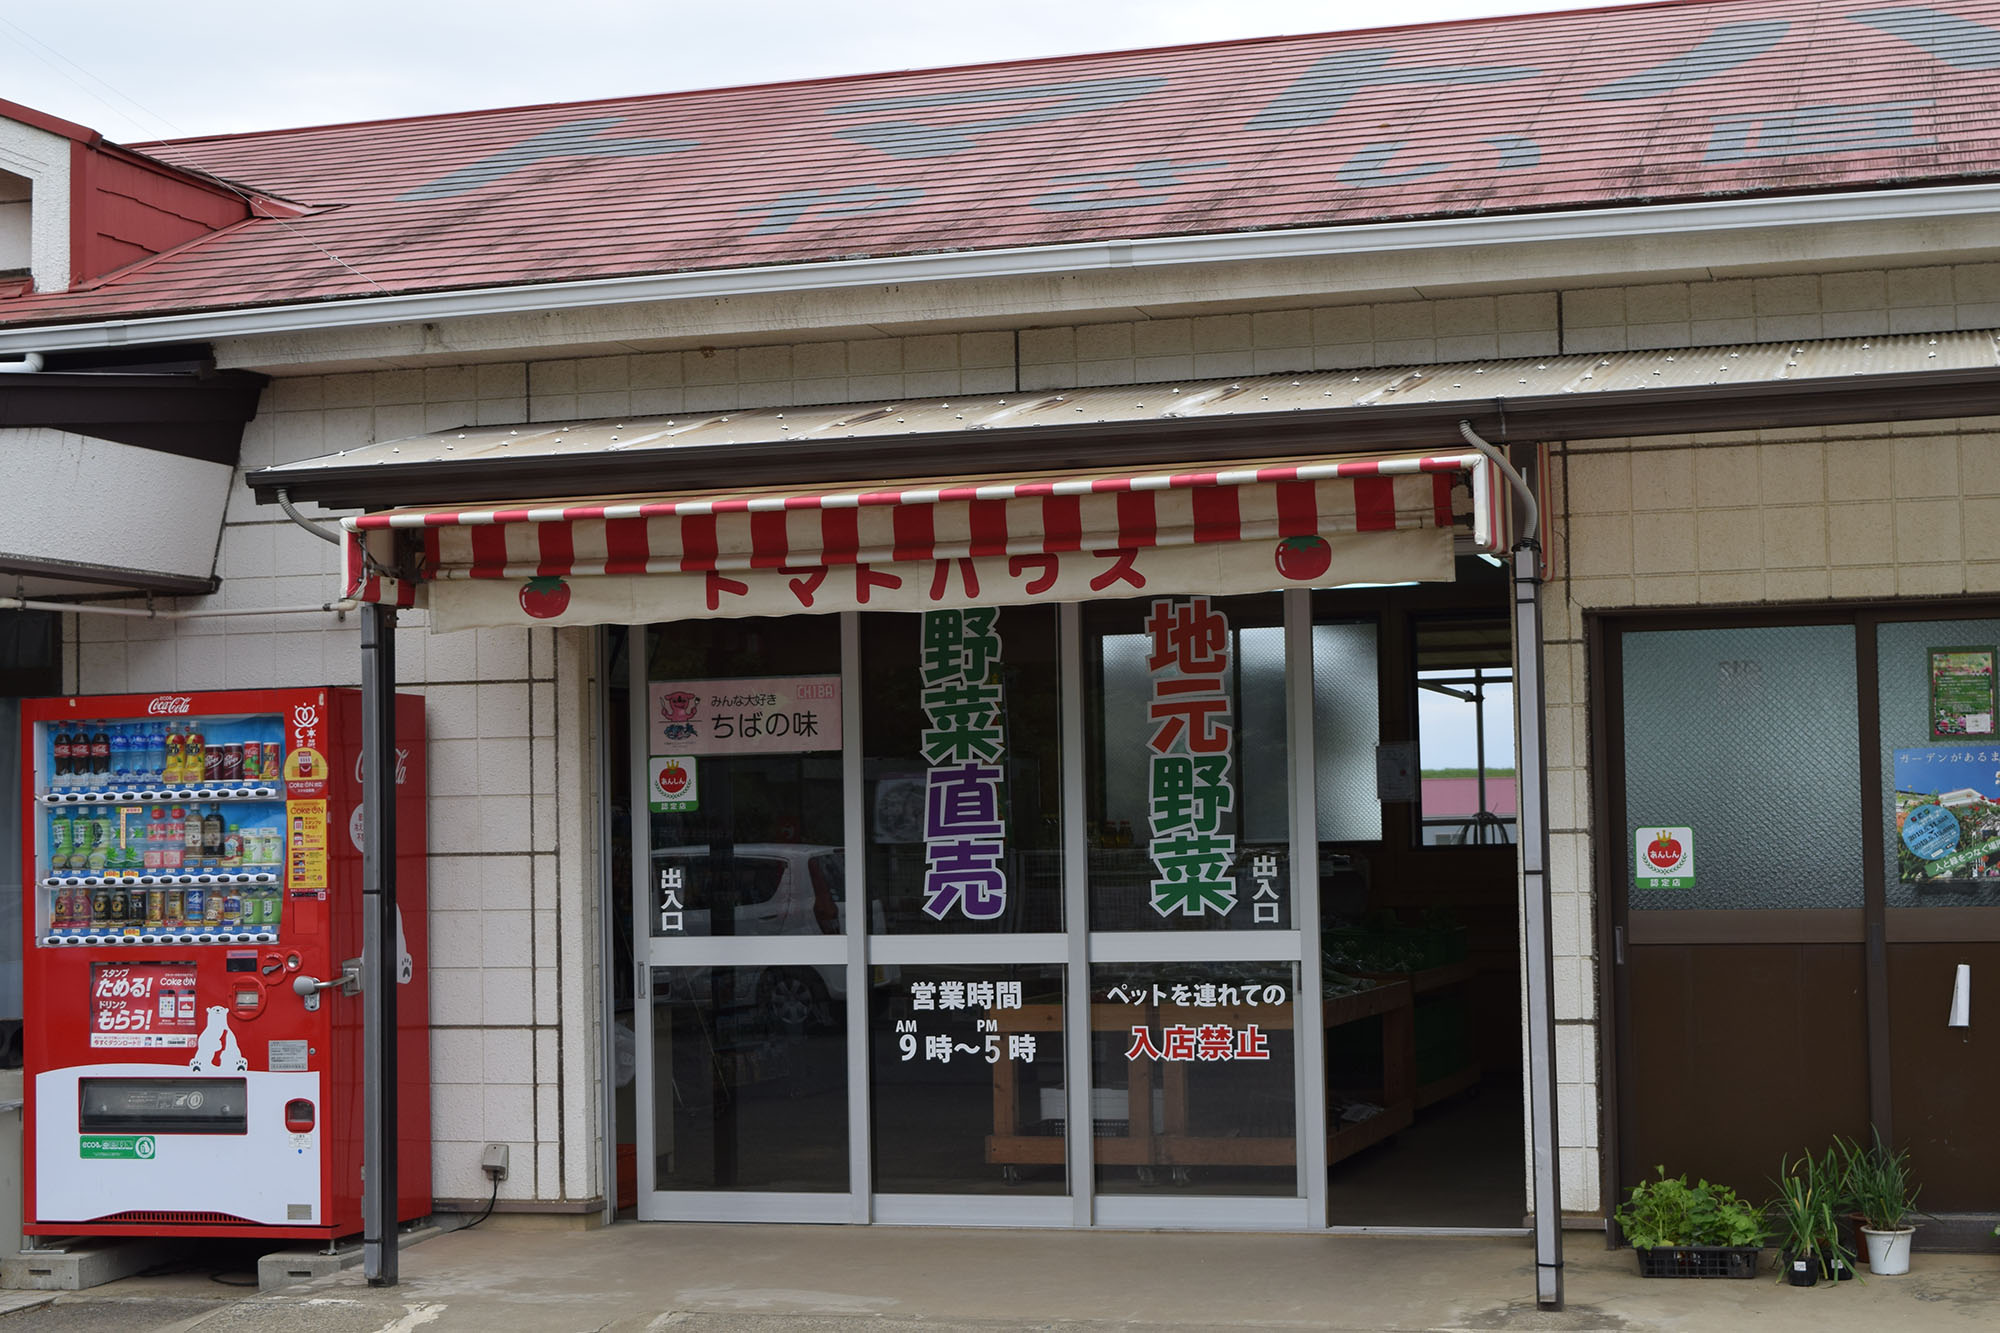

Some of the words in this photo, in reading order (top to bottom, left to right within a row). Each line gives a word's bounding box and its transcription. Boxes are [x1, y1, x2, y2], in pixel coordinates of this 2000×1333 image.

[706, 548, 1146, 611] トマトハウス
[797, 684, 835, 700] CHIBA
[148, 697, 192, 714] Coca-Cola
[711, 694, 777, 707] みんな大好き
[711, 711, 818, 739] ちばの味
[920, 606, 1006, 921] 野菜直売
[1145, 595, 1238, 918] 地元野菜
[661, 777, 687, 786] あんしん
[290, 807, 311, 815] Coke
[1650, 850, 1679, 859] あんしん
[1252, 855, 1279, 924] 出入口
[661, 868, 683, 931] 出入口
[101, 968, 130, 978] スタンプ
[160, 978, 182, 986] Coke
[183, 977, 196, 986] ON
[910, 981, 1022, 1010] 営業時間
[1107, 983, 1286, 1007] ペットを連れての
[99, 1001, 127, 1009] ドリンク
[895, 1020, 917, 1032] AM
[977, 1019, 998, 1032] PM
[1125, 1024, 1270, 1062] 入店禁止
